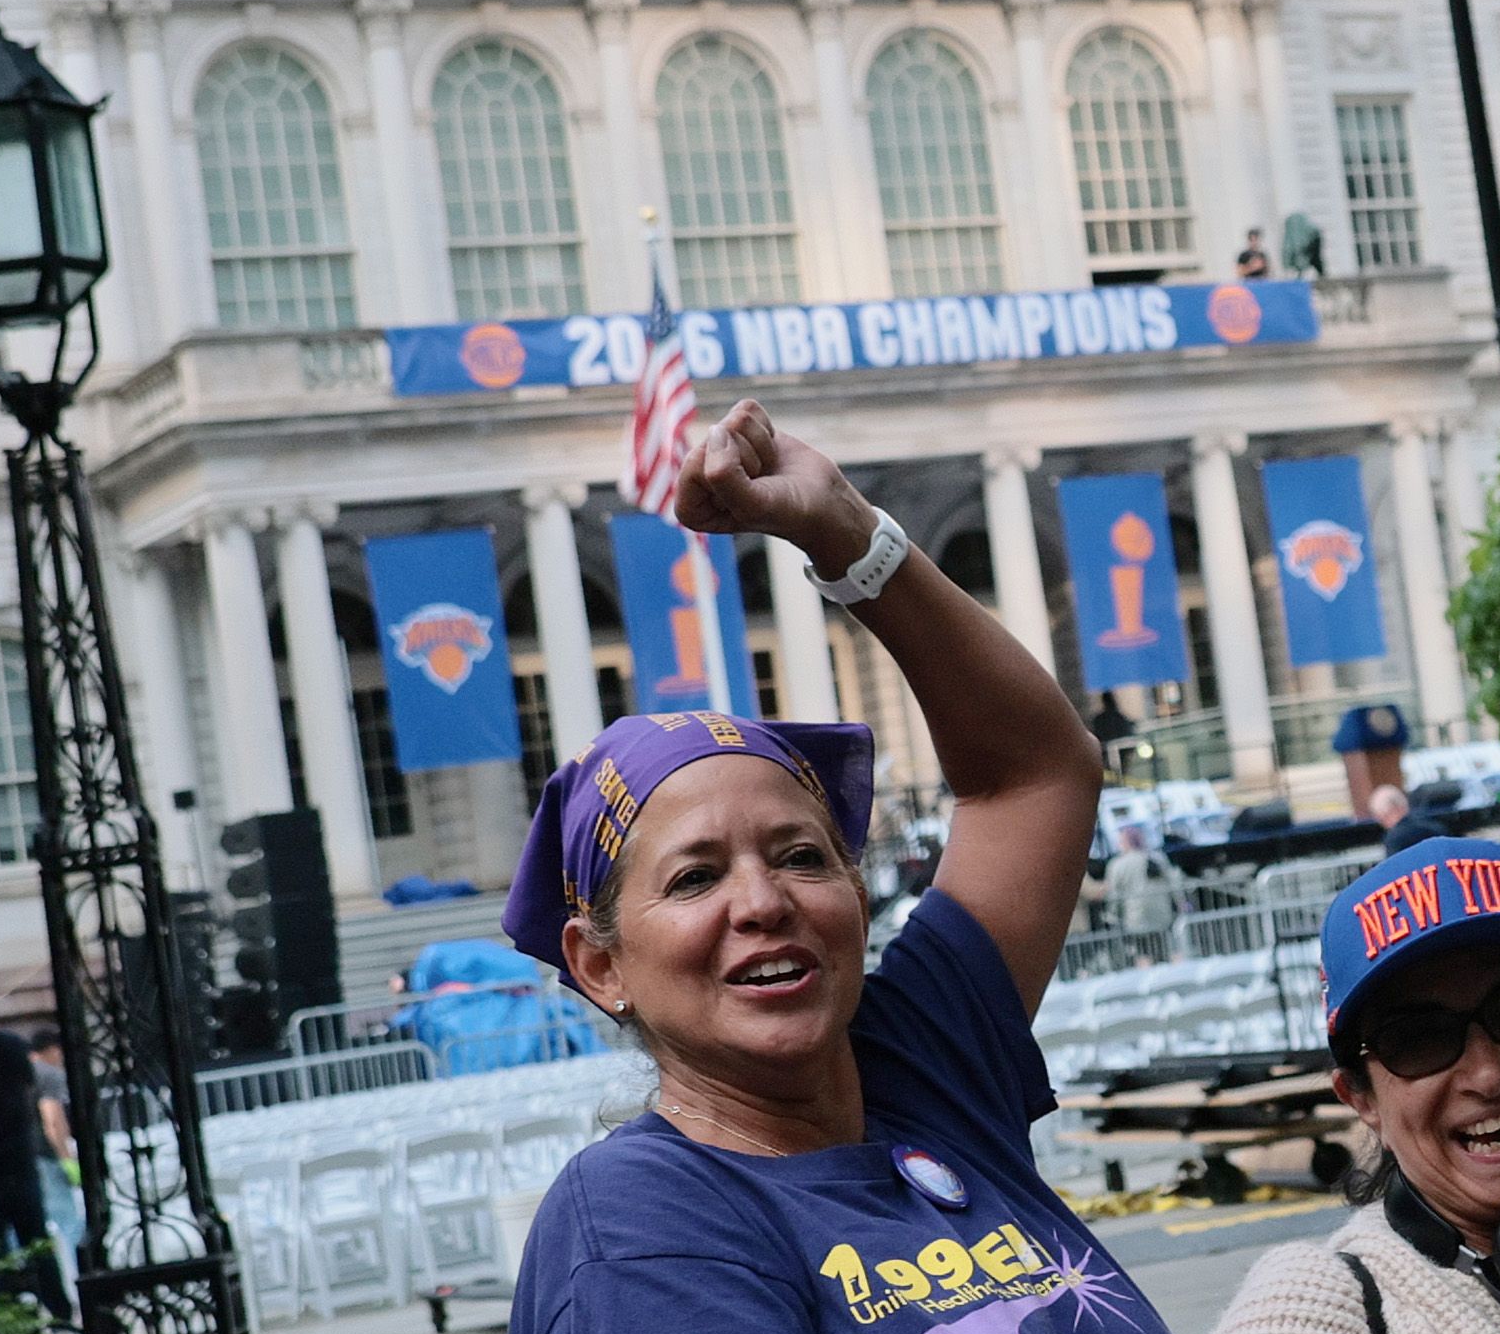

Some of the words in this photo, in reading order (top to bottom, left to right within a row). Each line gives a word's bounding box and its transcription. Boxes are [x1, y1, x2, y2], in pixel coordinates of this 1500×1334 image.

[564, 311, 725, 387] 206
[731, 304, 854, 376] NBA
[860, 284, 1177, 366] CHAMPIONS
[1354, 865, 1442, 961] NEW
